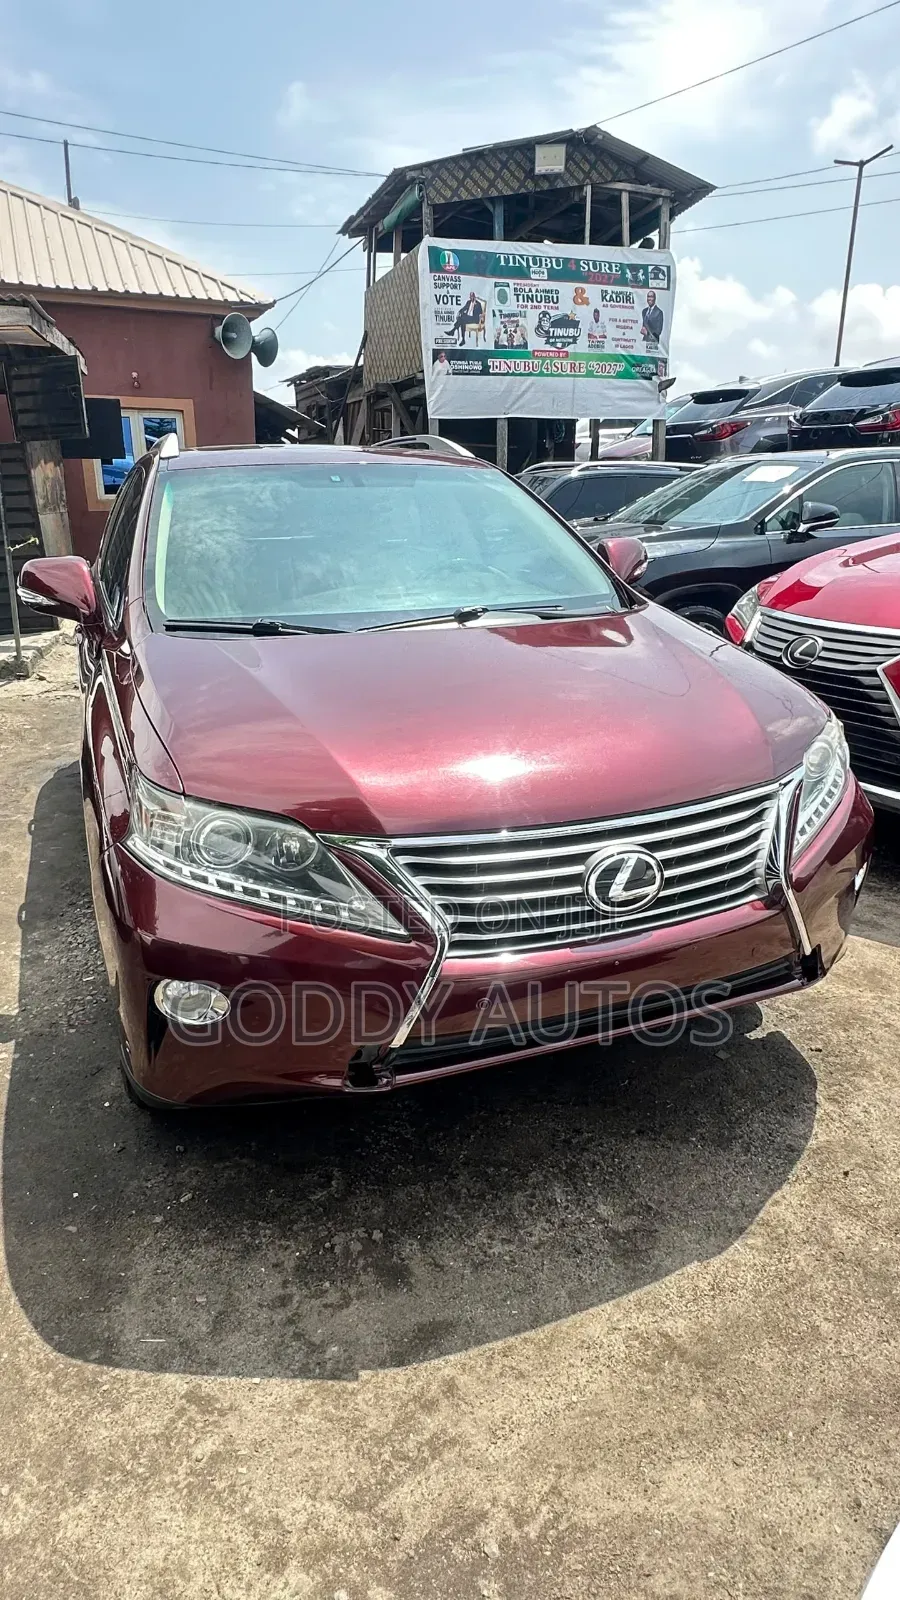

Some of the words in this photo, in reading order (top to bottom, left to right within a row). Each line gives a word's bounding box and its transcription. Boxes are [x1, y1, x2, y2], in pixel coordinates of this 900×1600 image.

[497, 254, 563, 270] TINUBU
[568, 258, 577, 271] 4
[580, 260, 621, 274] SURE
[433, 274, 461, 283] CANVASS
[532, 269, 545, 278] Hope
[433, 282, 461, 290] SUPPORT
[434, 294, 462, 306] VOTE
[514, 294, 560, 304] TINUBU
[573, 287, 590, 306] &
[601, 294, 635, 304] KADIRI
[550, 328, 580, 337] TINUBU
[488, 359, 540, 373] TINUBU
[542, 360, 550, 373] 4
[552, 361, 586, 374] SURE
